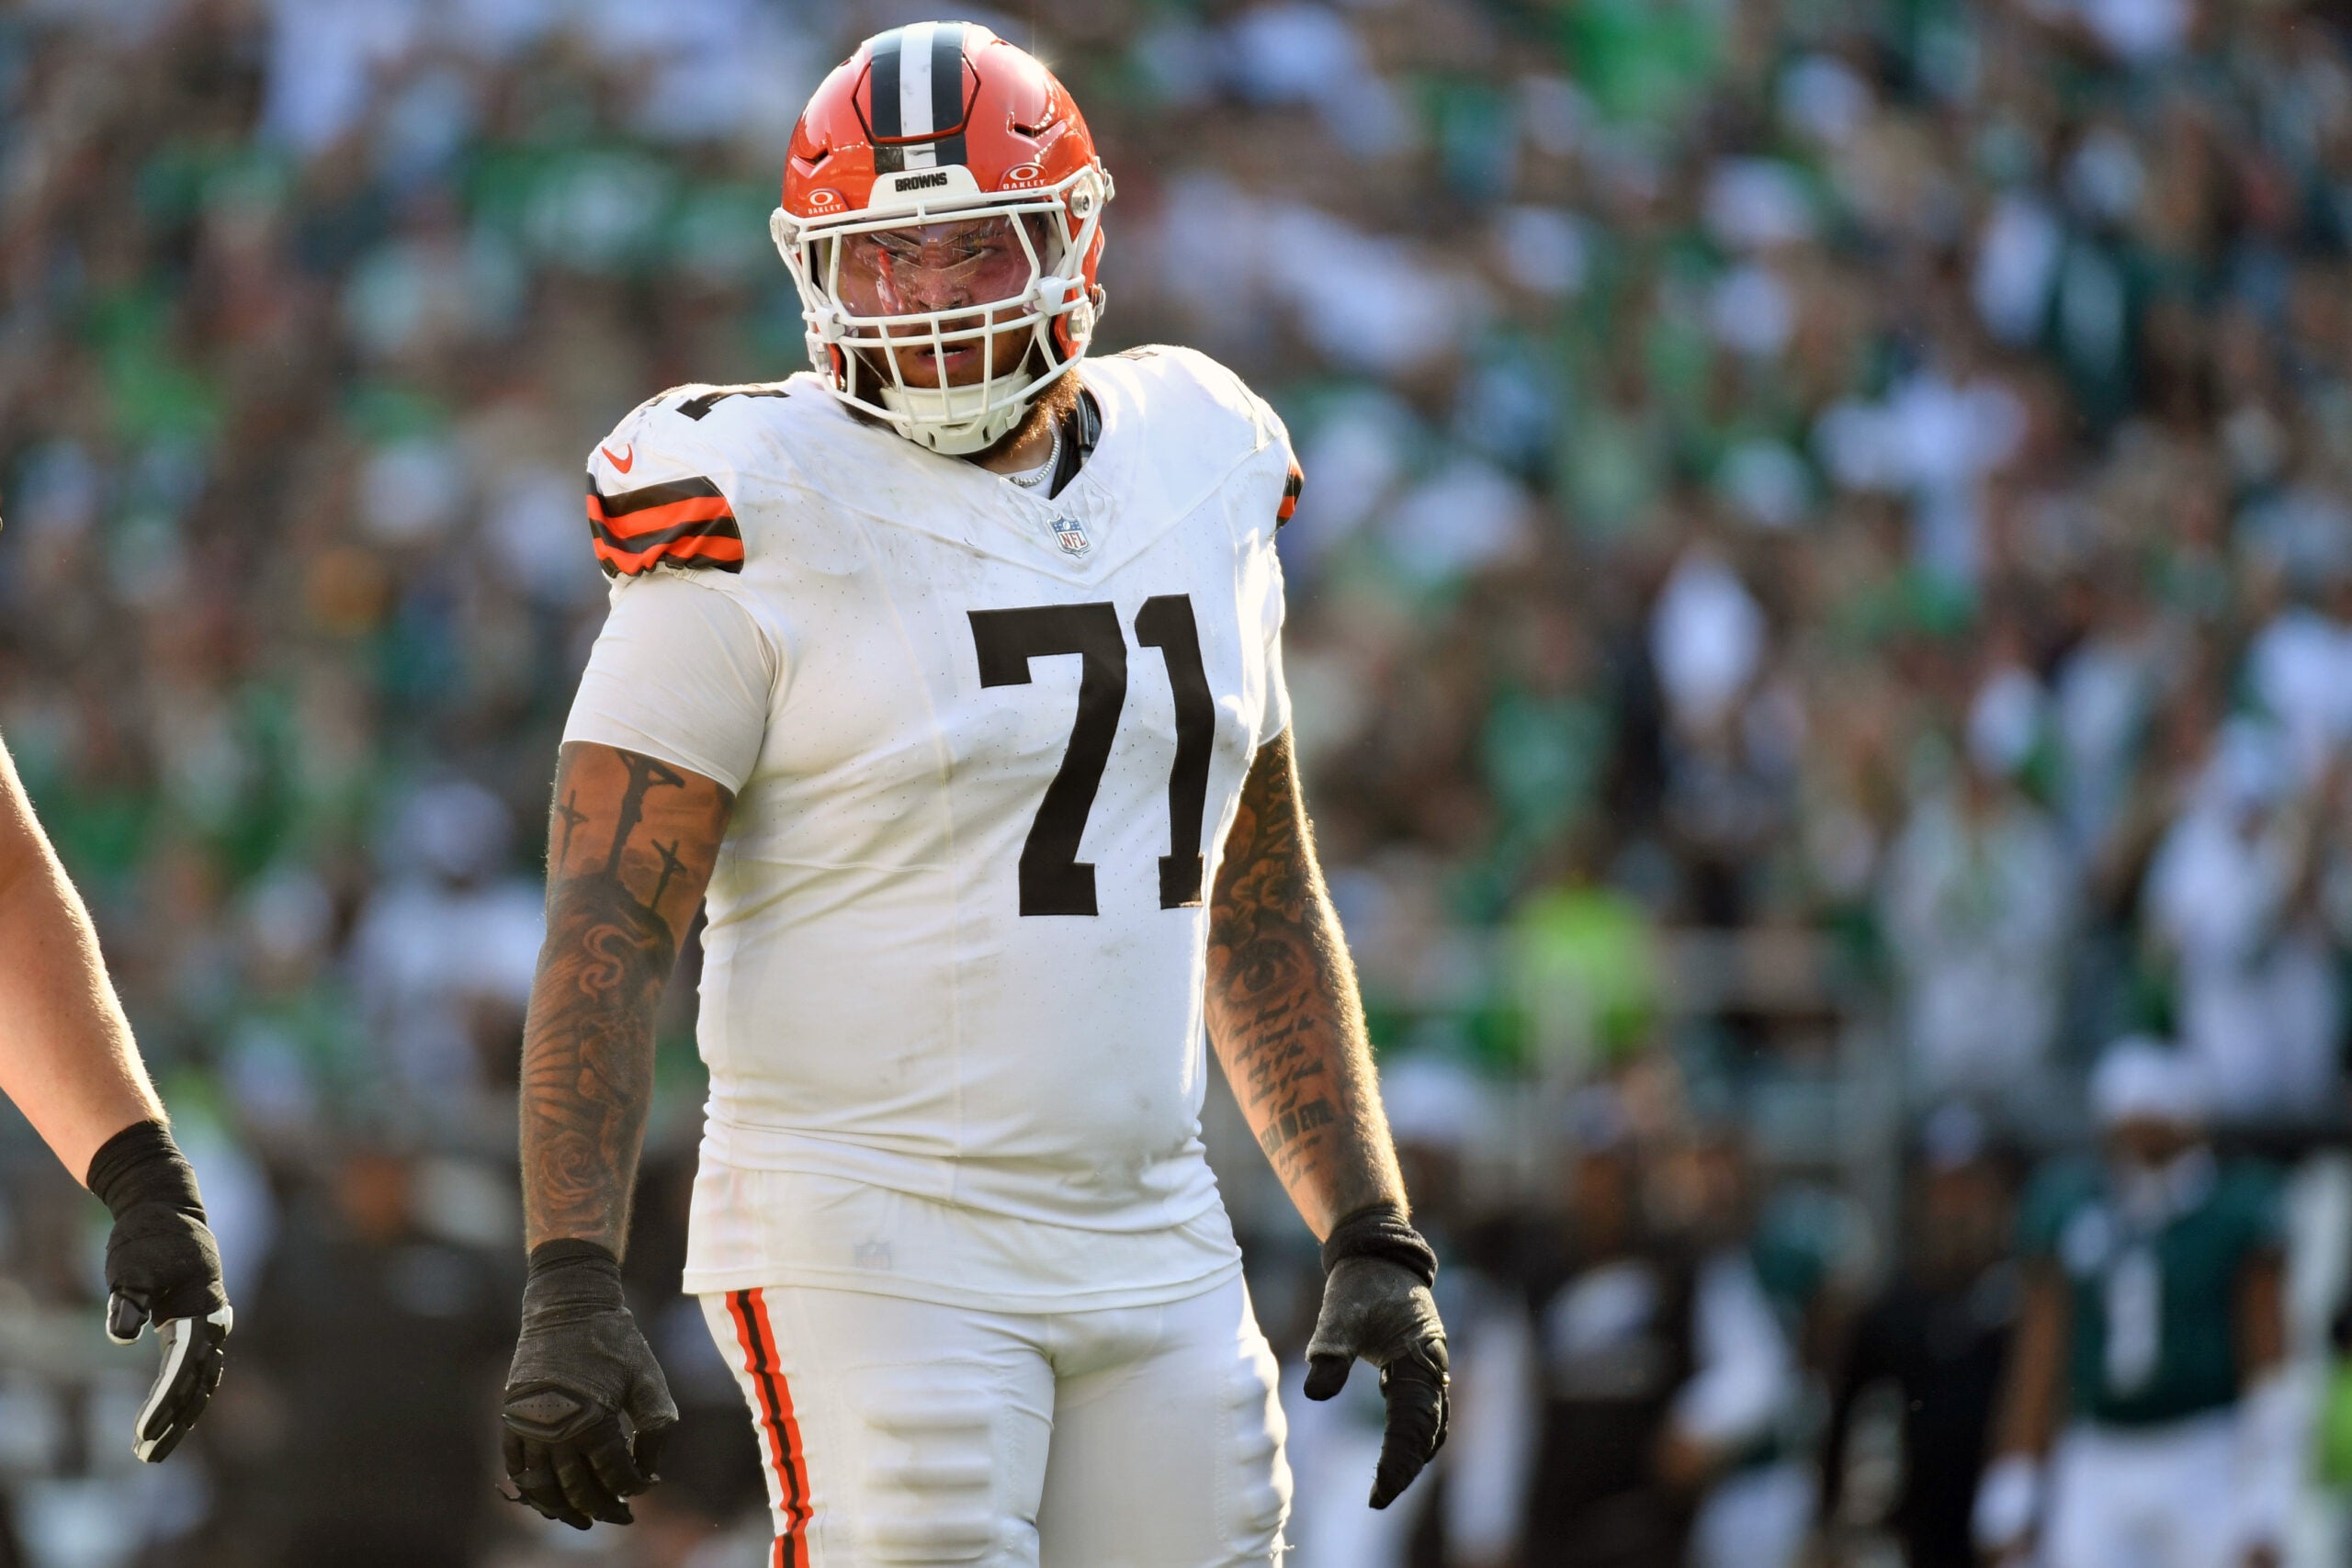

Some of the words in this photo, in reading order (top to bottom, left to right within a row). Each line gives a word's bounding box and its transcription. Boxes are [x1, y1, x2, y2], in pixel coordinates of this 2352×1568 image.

[895, 172, 947, 192] BROWNS
[1002, 179, 1045, 190] OAKLEY
[808, 203, 841, 215] OAKLEY
[1059, 532, 1086, 549] NFL
[967, 593, 1216, 917] 71
